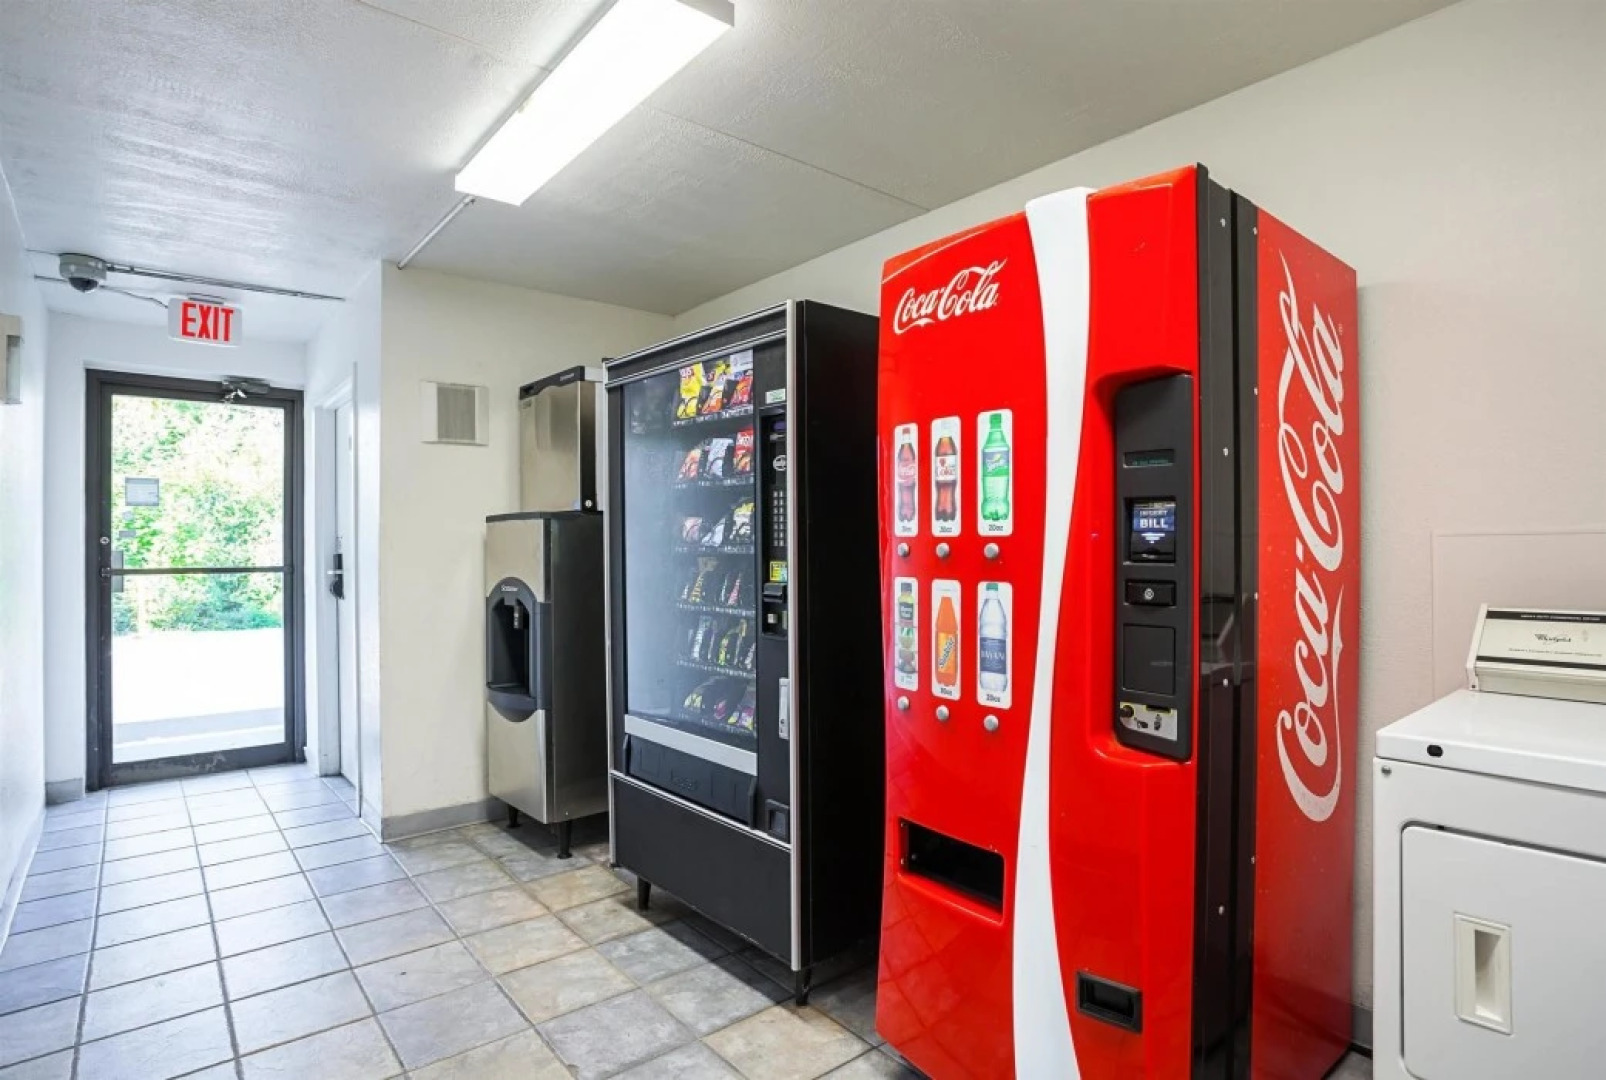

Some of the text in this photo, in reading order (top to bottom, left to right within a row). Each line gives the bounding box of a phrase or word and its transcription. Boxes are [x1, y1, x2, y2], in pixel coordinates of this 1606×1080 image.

[181, 301, 234, 352] EXIT
[893, 257, 1007, 335] Coca-Cola
[1140, 518, 1168, 529] BILL
[1277, 248, 1344, 822] Coca-Cola
